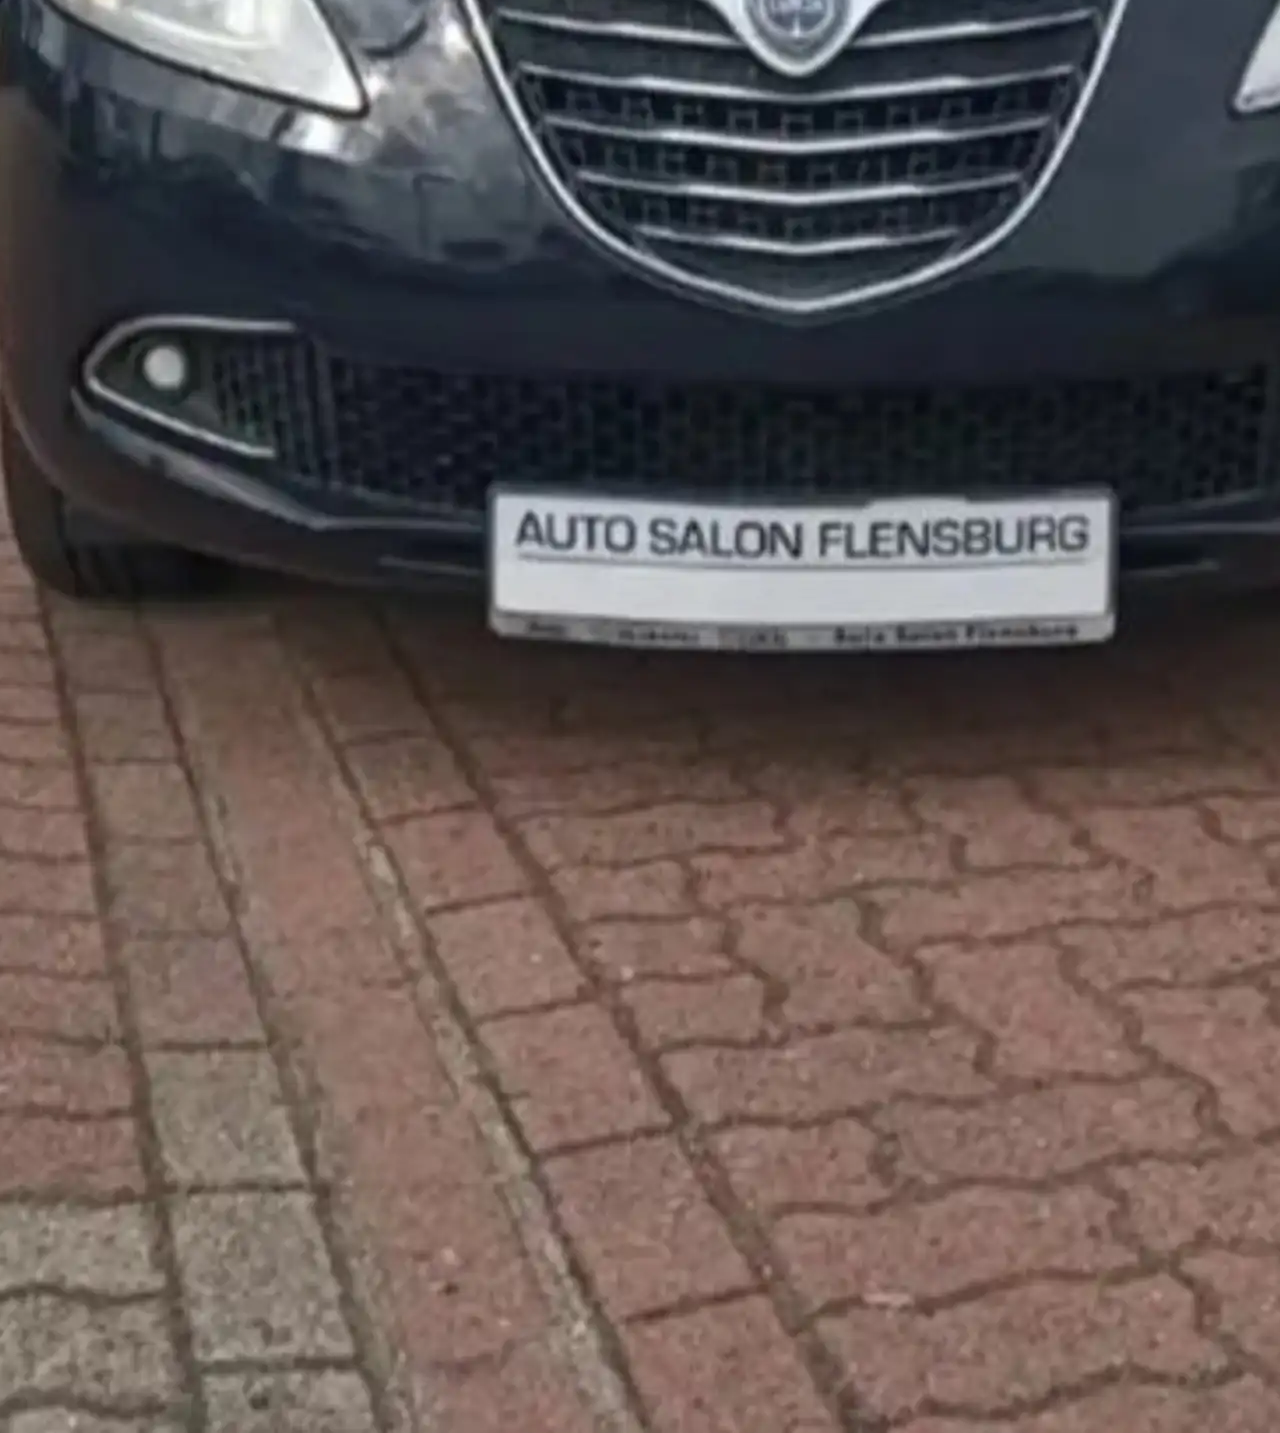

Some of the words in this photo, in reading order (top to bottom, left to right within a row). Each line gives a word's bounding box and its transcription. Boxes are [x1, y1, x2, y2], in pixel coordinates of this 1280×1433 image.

[515, 509, 637, 555] AUTO
[647, 517, 803, 559] SALON
[818, 514, 1091, 559] FLENSBURG
